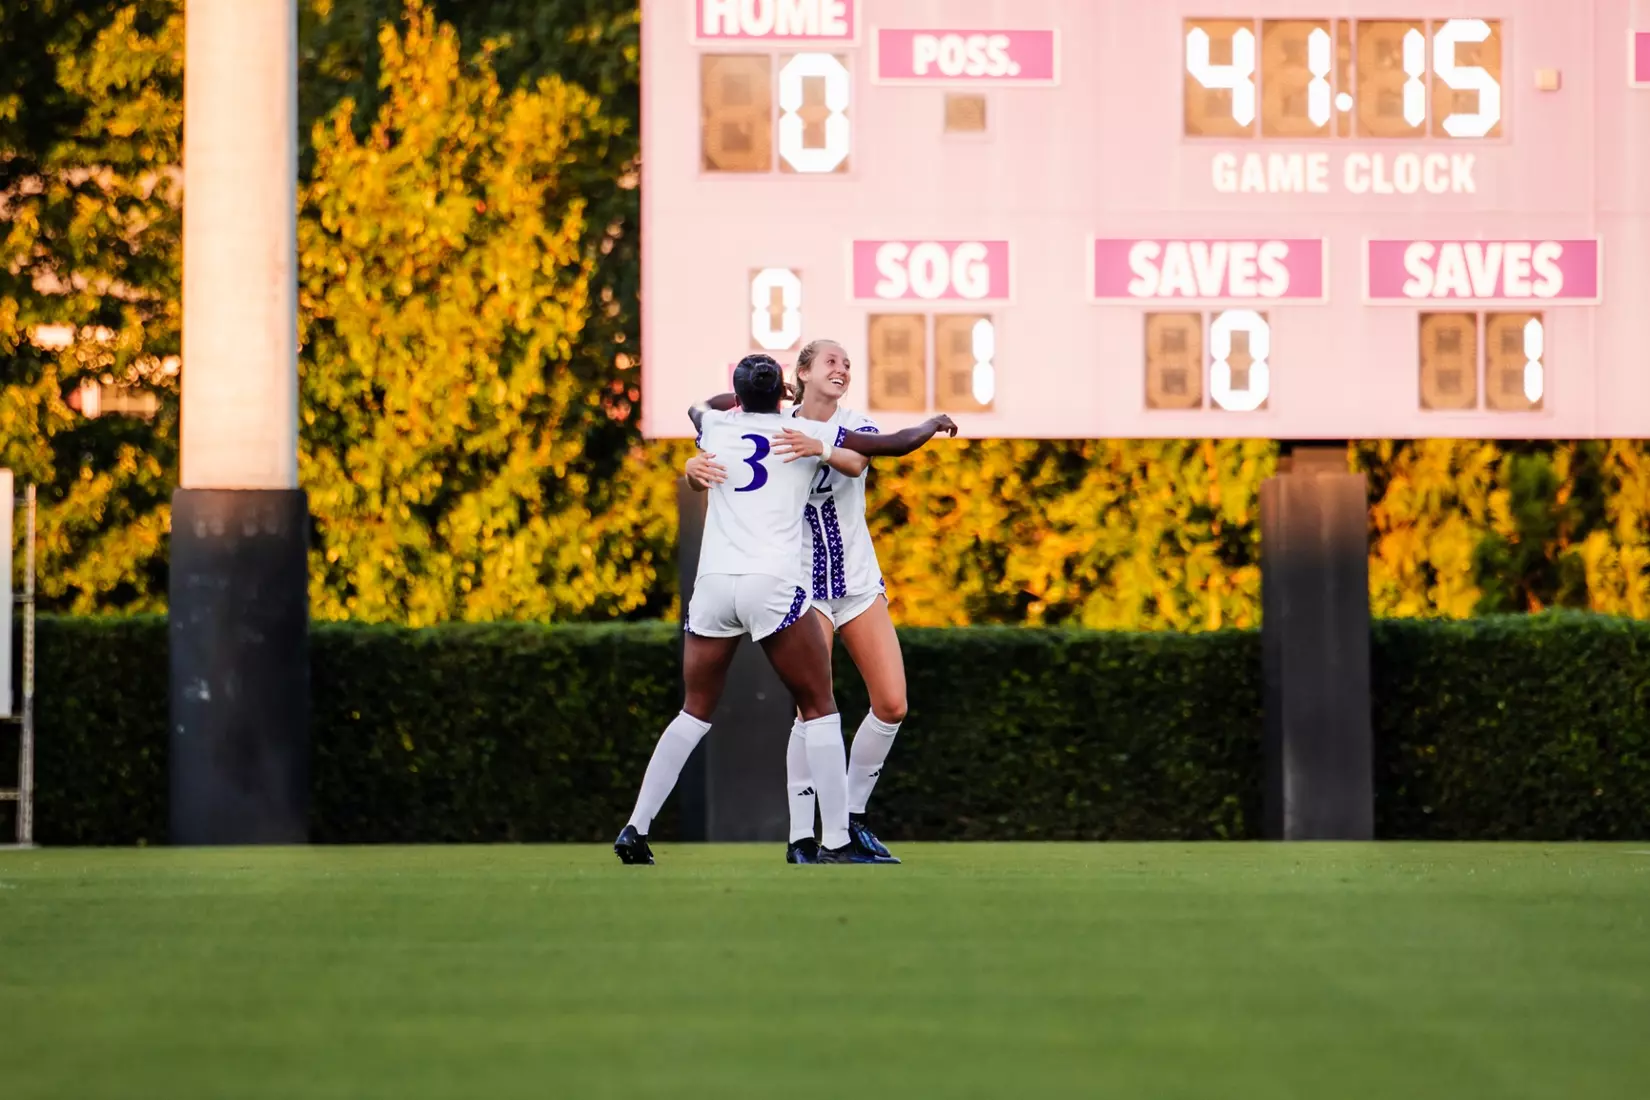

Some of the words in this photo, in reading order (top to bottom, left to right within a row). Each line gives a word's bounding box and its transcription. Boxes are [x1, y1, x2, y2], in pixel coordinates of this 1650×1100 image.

[703, 0, 848, 36] HOME
[912, 34, 1020, 77] POSS.
[779, 53, 850, 173] 0
[1211, 152, 1329, 194] GAME
[1344, 152, 1477, 195] CLOCK
[874, 241, 991, 299] SOG
[1127, 240, 1290, 298] SAVES
[1402, 241, 1564, 299] SAVES
[751, 268, 802, 350] 0
[1210, 310, 1270, 412] 0
[734, 433, 770, 492] 3
